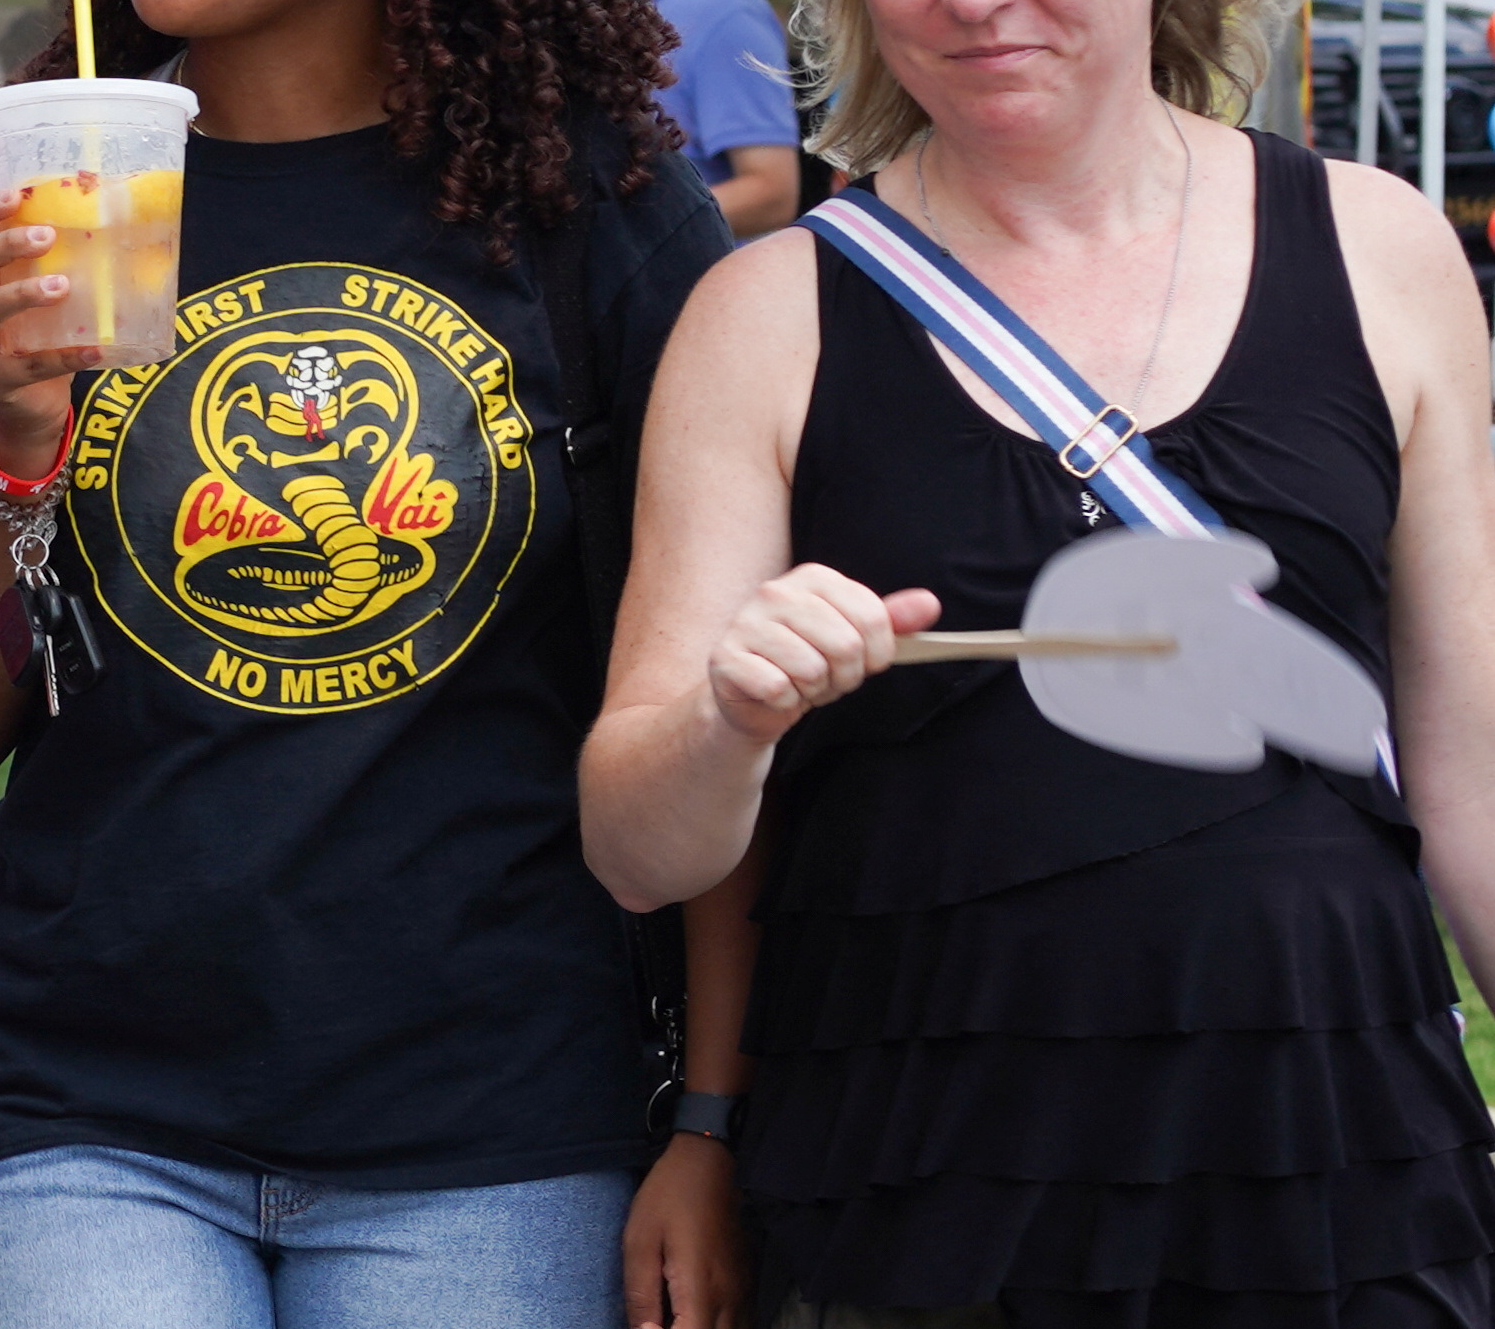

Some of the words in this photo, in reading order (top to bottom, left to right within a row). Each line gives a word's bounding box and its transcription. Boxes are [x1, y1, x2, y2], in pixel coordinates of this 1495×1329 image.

[74, 361, 164, 493] STRIKE
[175, 279, 268, 345] IRST
[340, 273, 487, 368] STRIKE
[468, 355, 537, 471] HARD
[183, 481, 287, 547] Cobra
[367, 457, 451, 535] Kai
[204, 648, 267, 698] NO
[280, 639, 420, 704] MERCY
